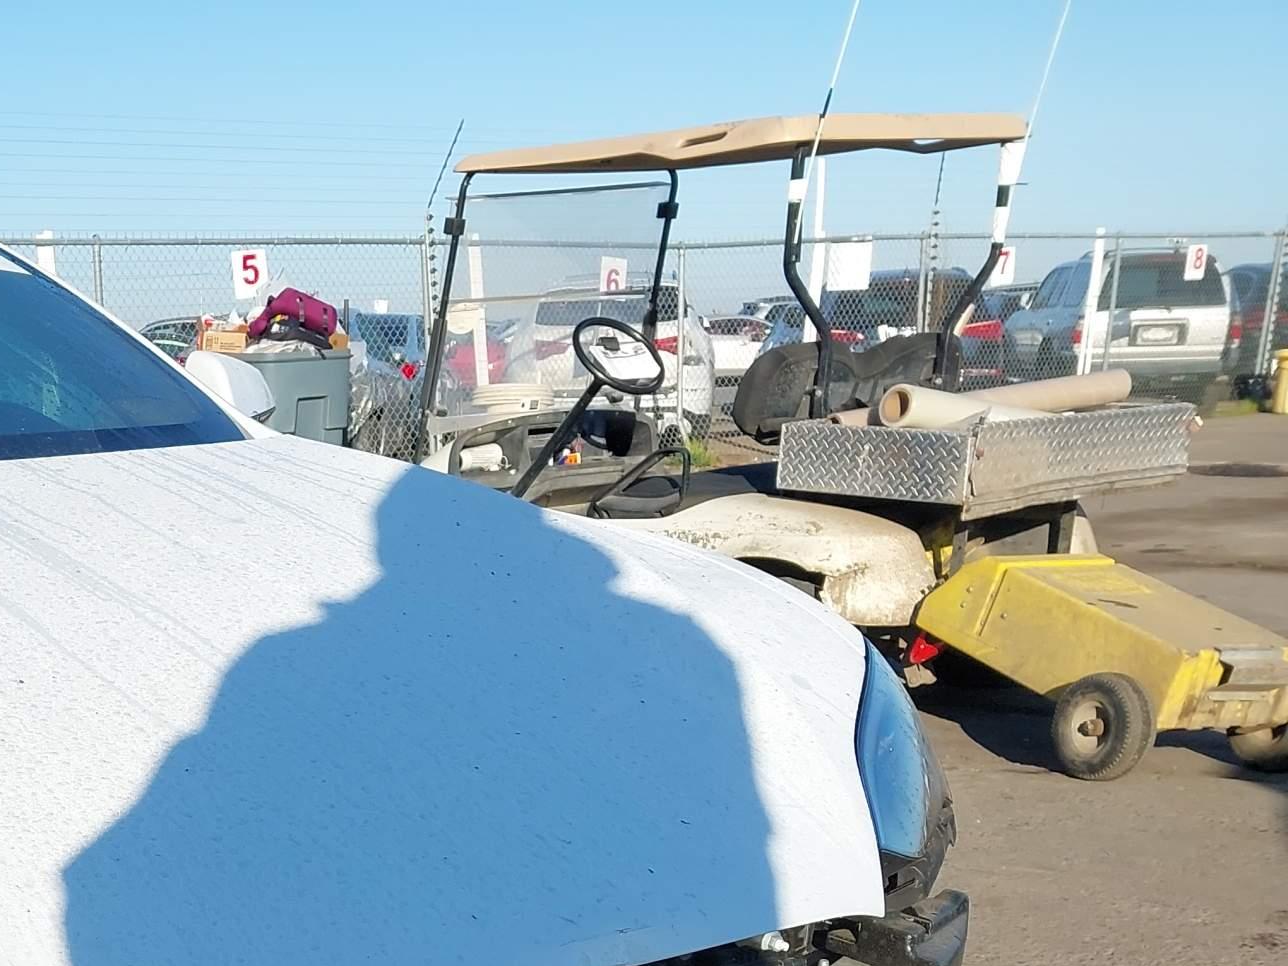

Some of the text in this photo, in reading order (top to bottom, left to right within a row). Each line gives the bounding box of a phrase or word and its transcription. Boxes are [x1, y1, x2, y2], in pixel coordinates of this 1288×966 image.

[242, 254, 259, 285] 5
[1193, 247, 1203, 269] 8
[606, 268, 620, 291] 6
